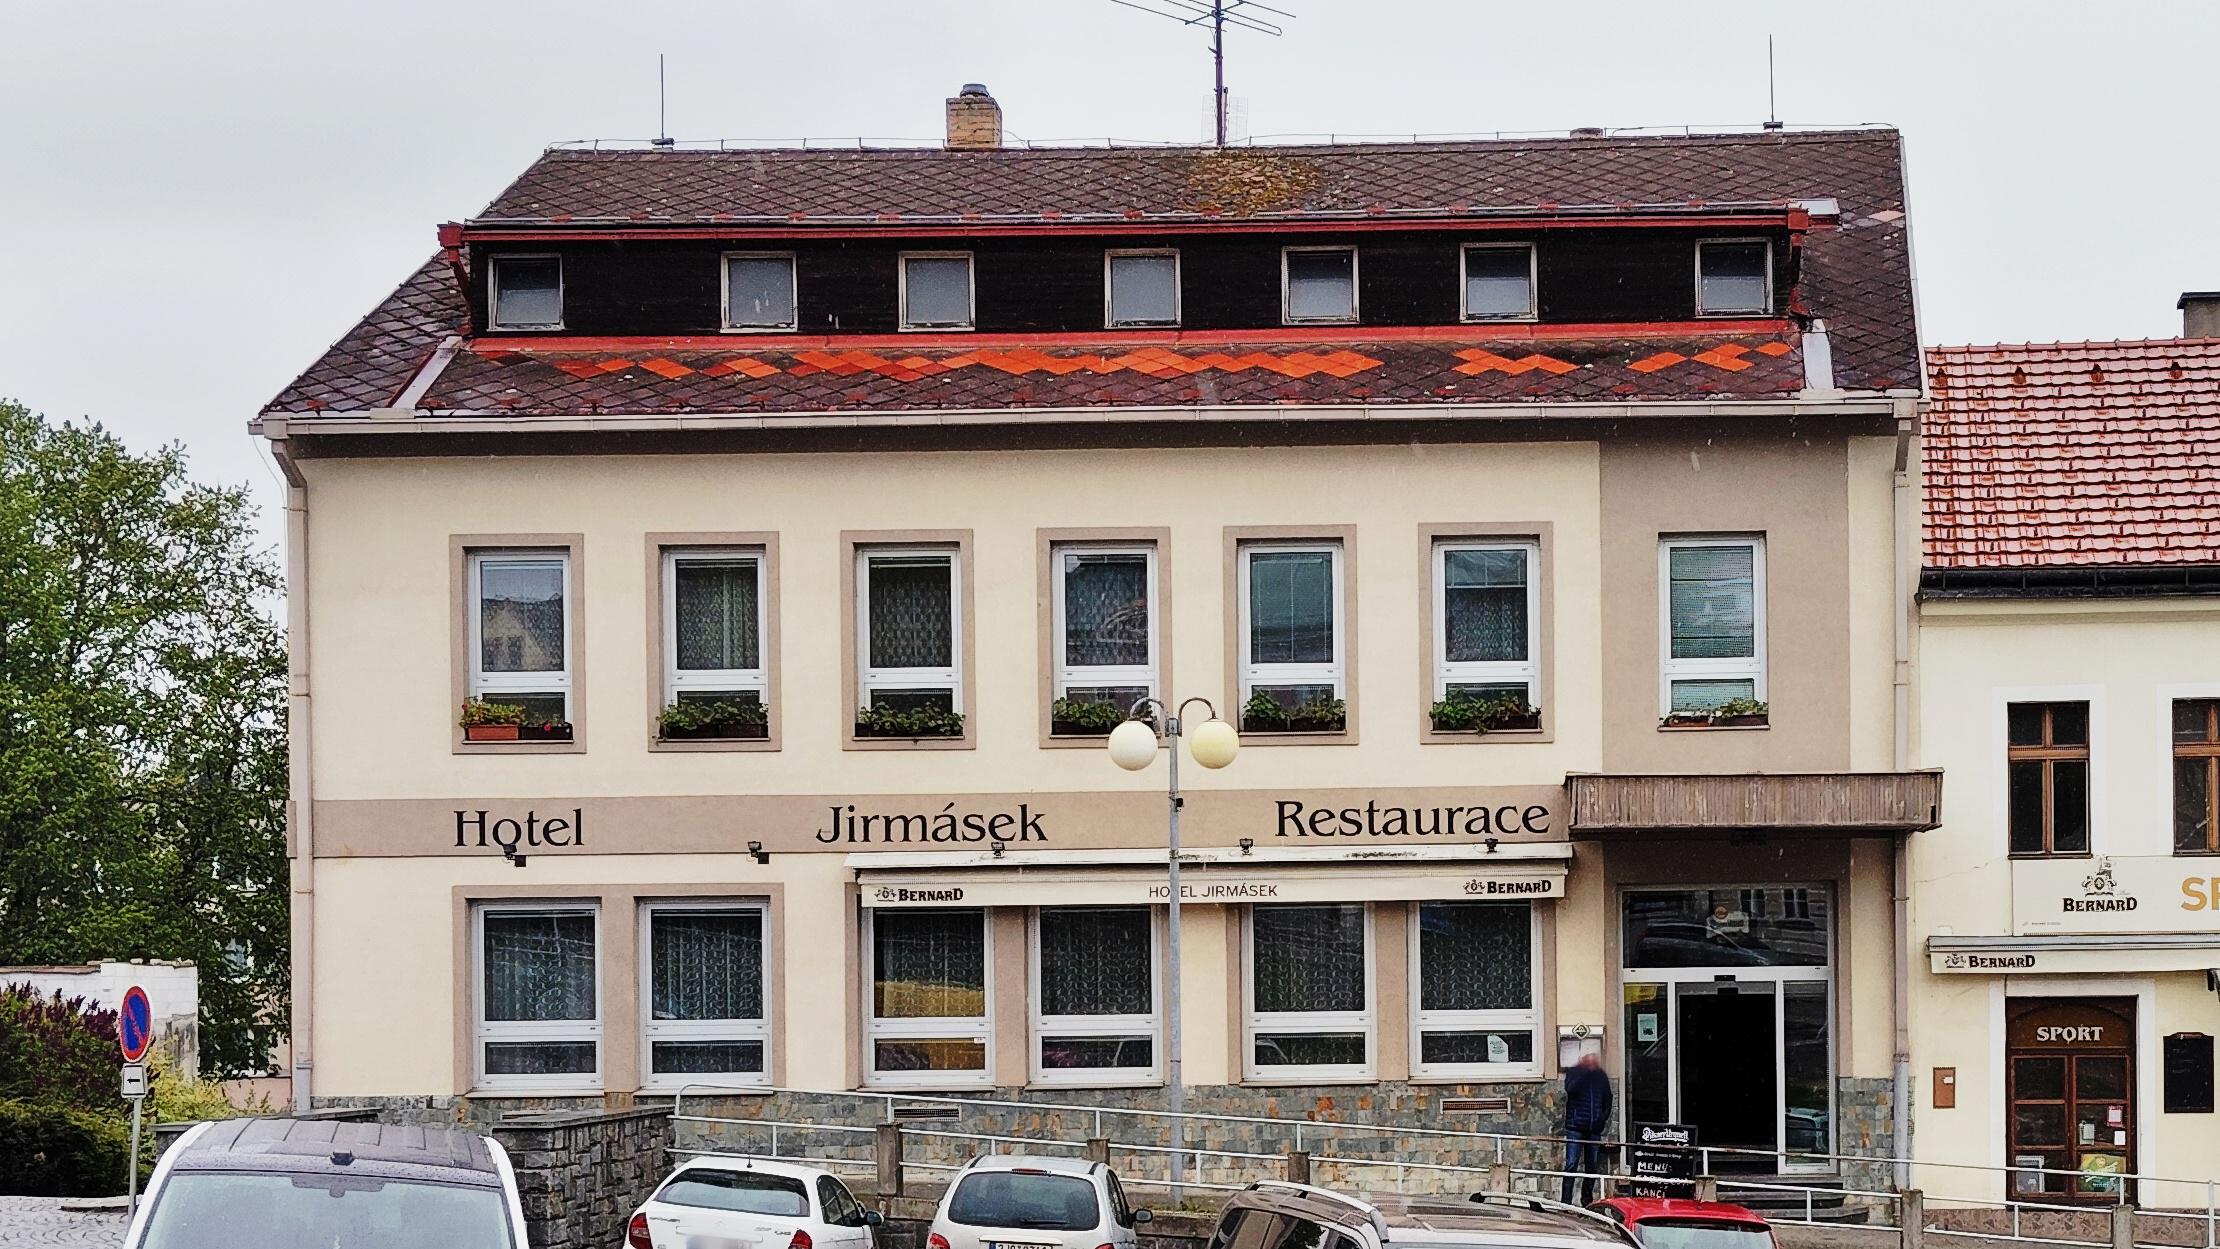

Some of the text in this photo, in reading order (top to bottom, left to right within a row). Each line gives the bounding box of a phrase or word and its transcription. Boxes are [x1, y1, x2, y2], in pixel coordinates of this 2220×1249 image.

[453, 799, 1551, 847] Hotel Jirmásek Restaurace
[898, 887, 964, 902] BERNARD
[1149, 882, 1278, 898] HOEL JIRMÁSEK
[1486, 879, 1552, 894] BERNARD
[2062, 896, 2138, 912] BERNARD
[1968, 954, 2036, 968] BERNARD
[2036, 1025, 2104, 1042] SPORT
